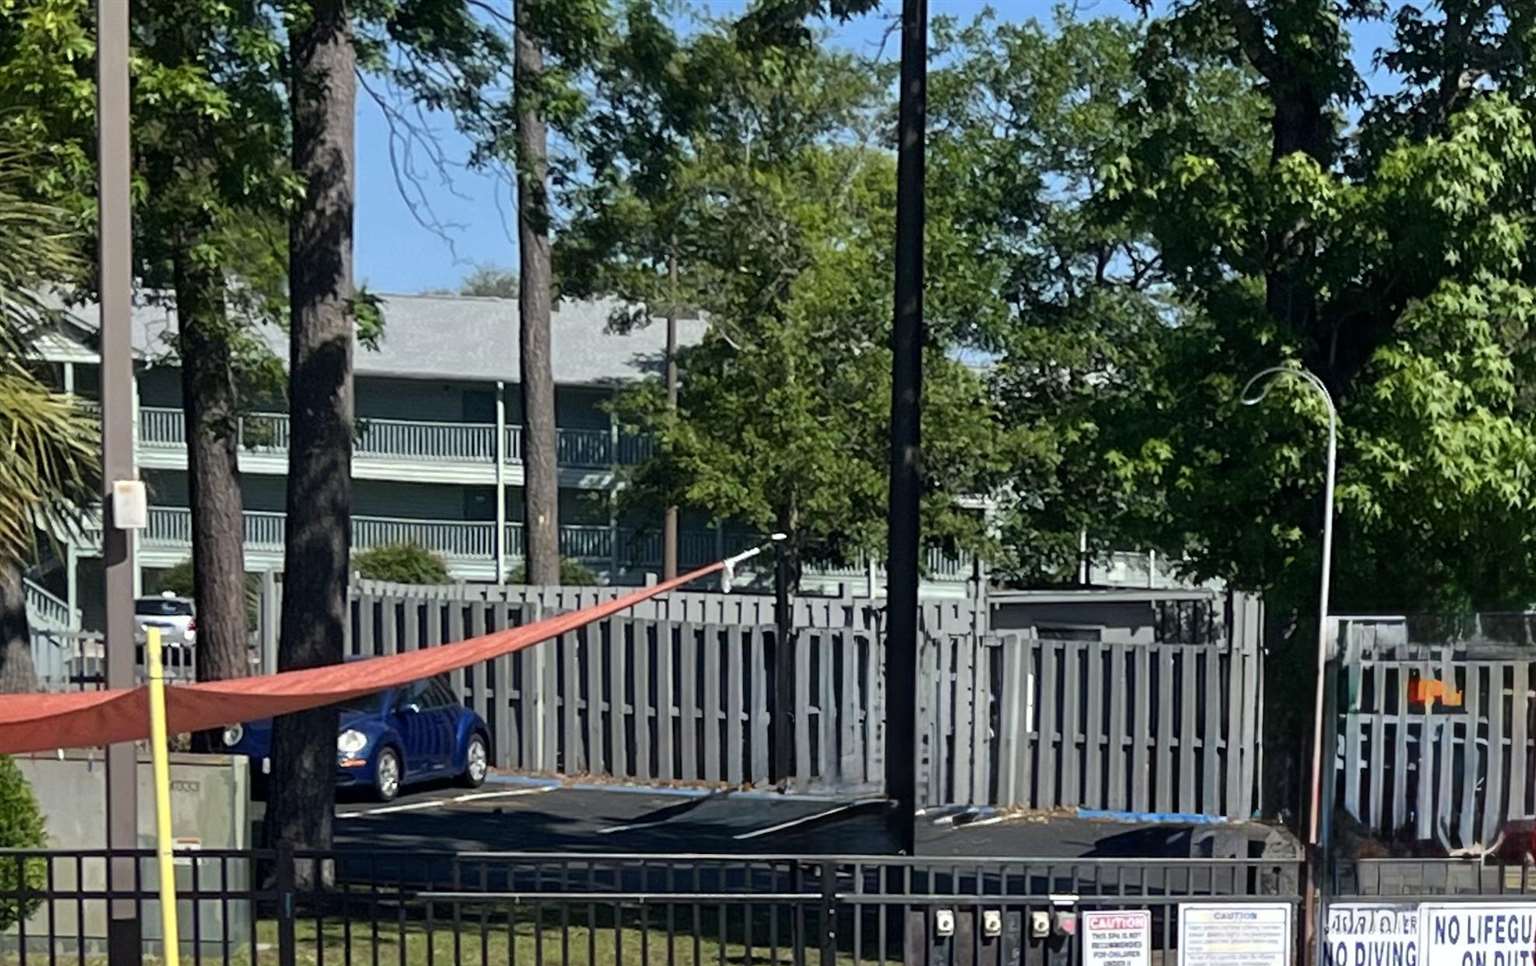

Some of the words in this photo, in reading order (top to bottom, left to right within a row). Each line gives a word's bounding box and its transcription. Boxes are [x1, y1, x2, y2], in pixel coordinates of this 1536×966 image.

[1089, 916, 1144, 929] CAUTION
[1213, 912, 1258, 920] CAUTION
[1435, 914, 1460, 945] NO
[1467, 914, 1536, 944] LIFEGU
